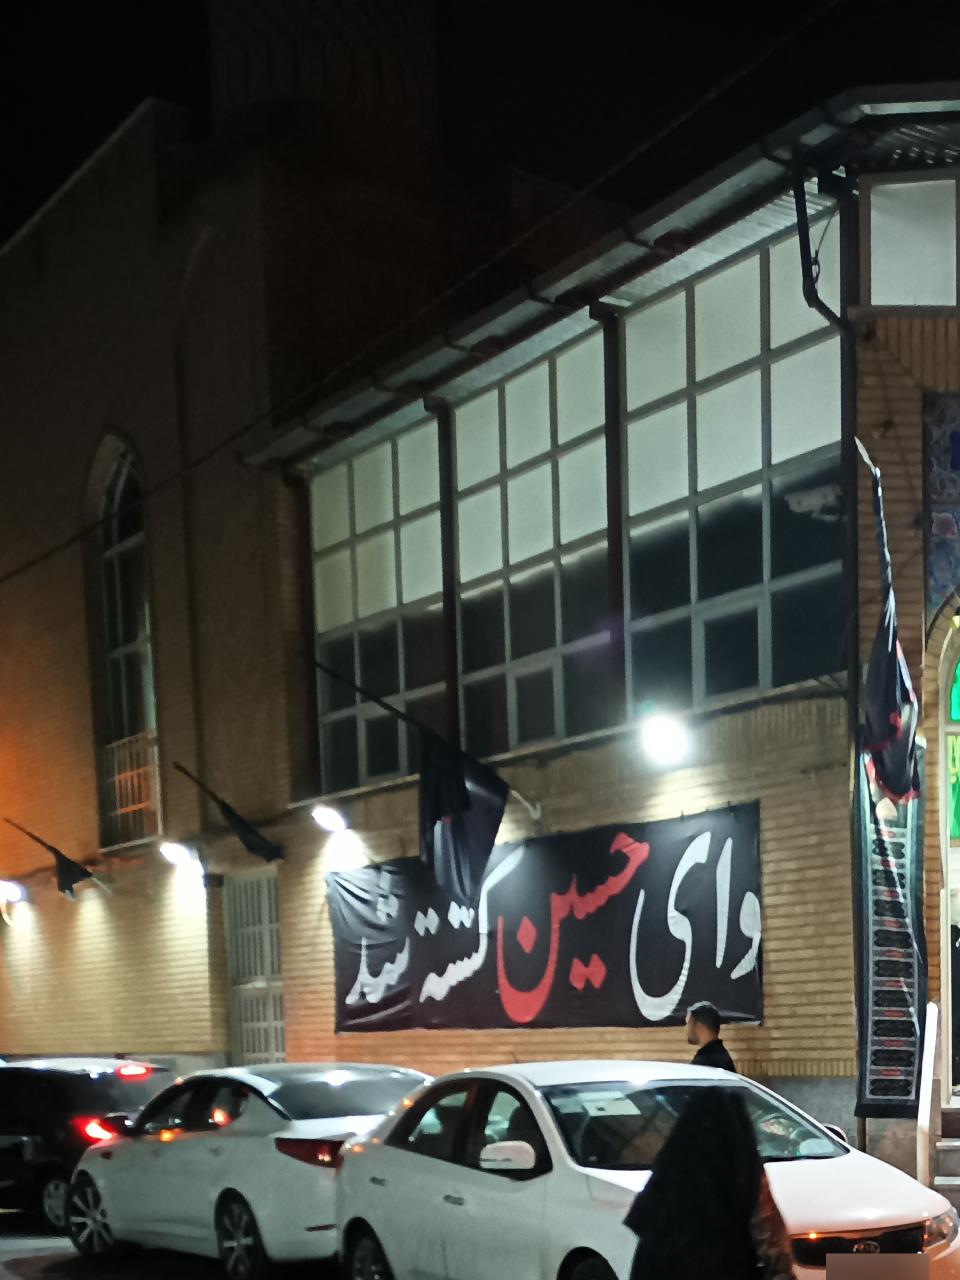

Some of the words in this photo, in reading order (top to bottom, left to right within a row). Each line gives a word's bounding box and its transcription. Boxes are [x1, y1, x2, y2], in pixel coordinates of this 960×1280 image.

[345, 871, 411, 1005] شد
[414, 846, 526, 1004] کشته
[496, 831, 650, 1023] حسین
[629, 831, 762, 1021] وای
